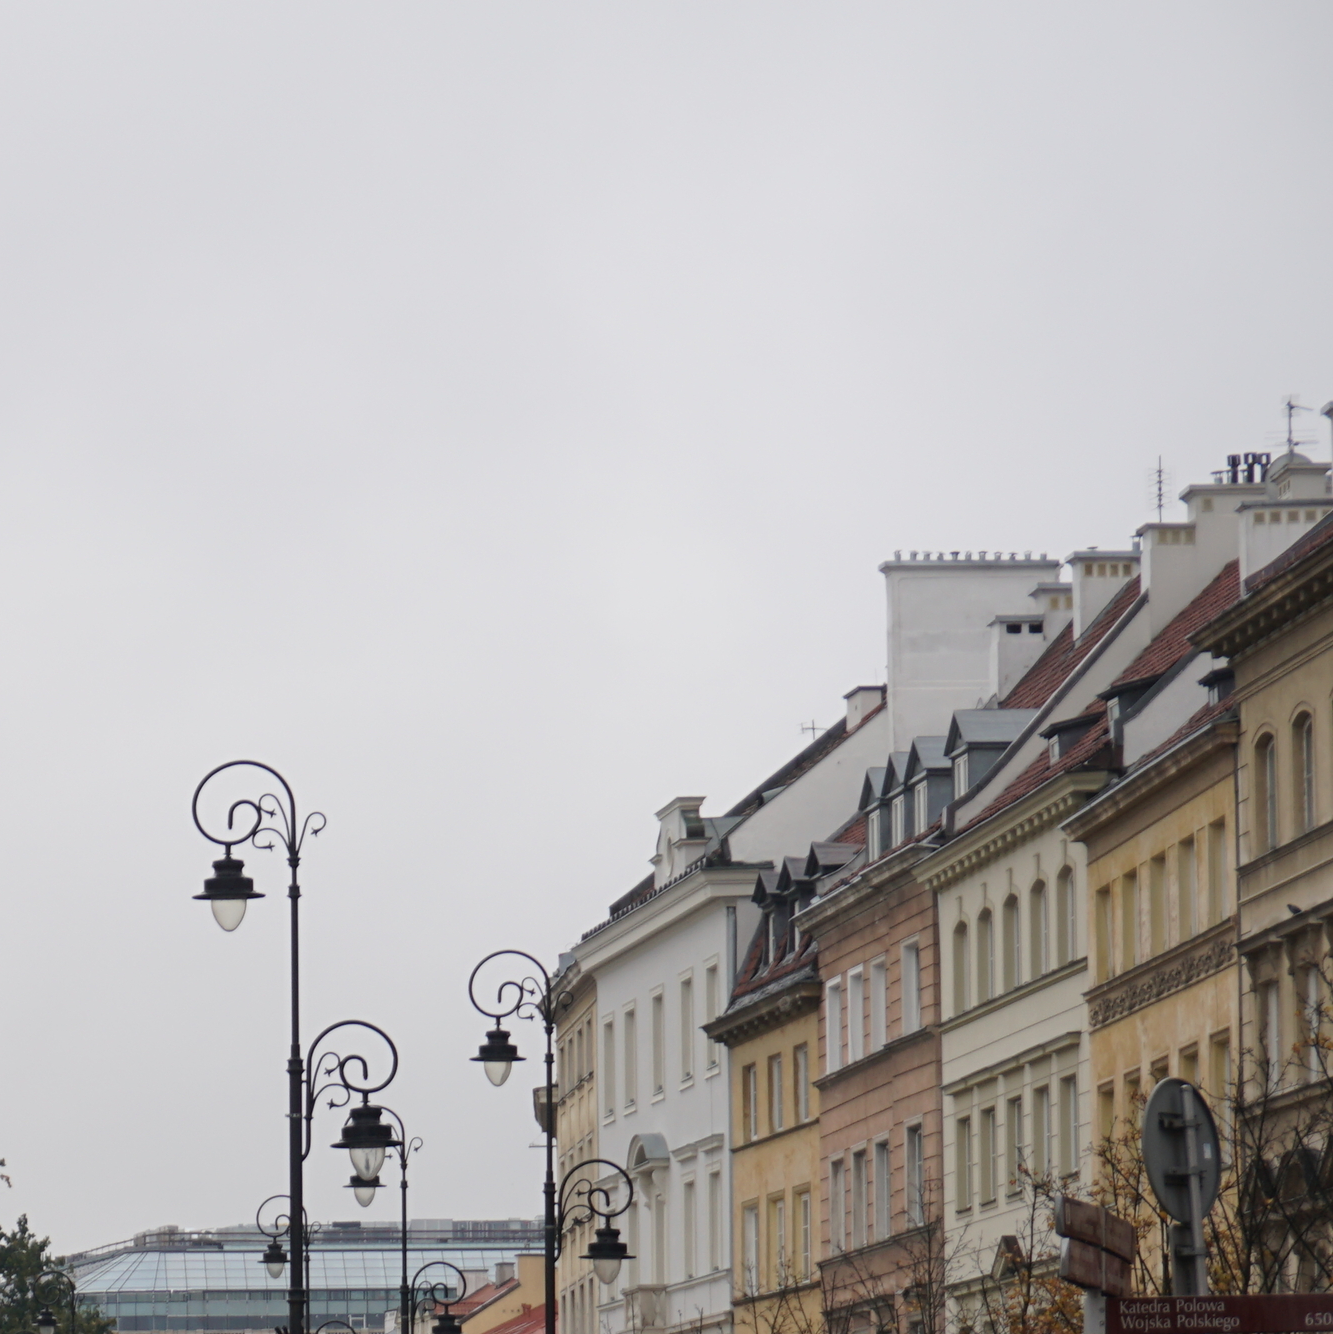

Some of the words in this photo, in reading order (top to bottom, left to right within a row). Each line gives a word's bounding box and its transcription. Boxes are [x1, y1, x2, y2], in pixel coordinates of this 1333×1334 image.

[1120, 1300, 1170, 1314] Katedra
[1176, 1298, 1225, 1312] Polowa
[1121, 1315, 1171, 1332] Wojska
[1176, 1313, 1240, 1331] Polskiego
[1305, 1312, 1333, 1326] 650
